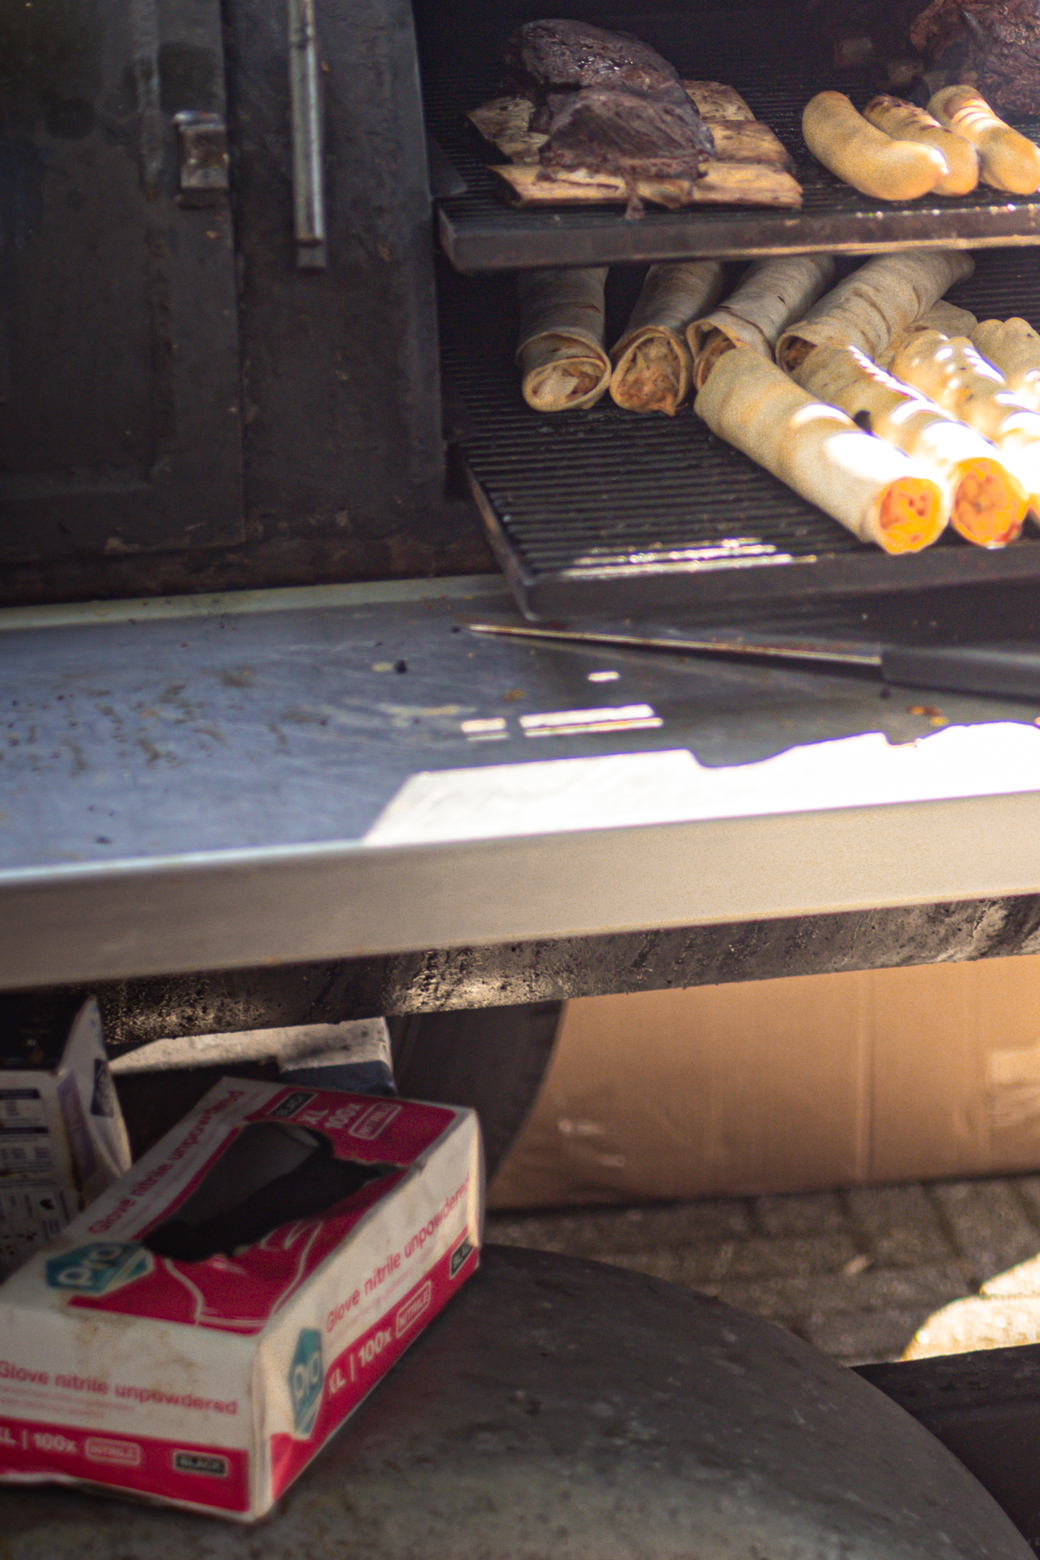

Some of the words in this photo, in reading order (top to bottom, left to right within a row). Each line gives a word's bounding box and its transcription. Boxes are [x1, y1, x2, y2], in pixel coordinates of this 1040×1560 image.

[298, 1109, 329, 1125] XL
[324, 1103, 364, 1129] 100x
[88, 1199, 136, 1234] Glove
[130, 1164, 173, 1196] nitrile
[168, 1090, 246, 1161] unpowdered
[326, 1290, 360, 1333] Glove
[364, 1253, 401, 1296] nitrile
[403, 1172, 470, 1259] unpowdered
[399, 1290, 429, 1327] NITRILE
[327, 1367, 346, 1395] XL
[358, 1327, 392, 1368] 100x
[0, 1360, 49, 1386] Glove
[55, 1372, 109, 1395] nitrile
[115, 1383, 238, 1415] unpowdered
[33, 1433, 78, 1453] 100x
